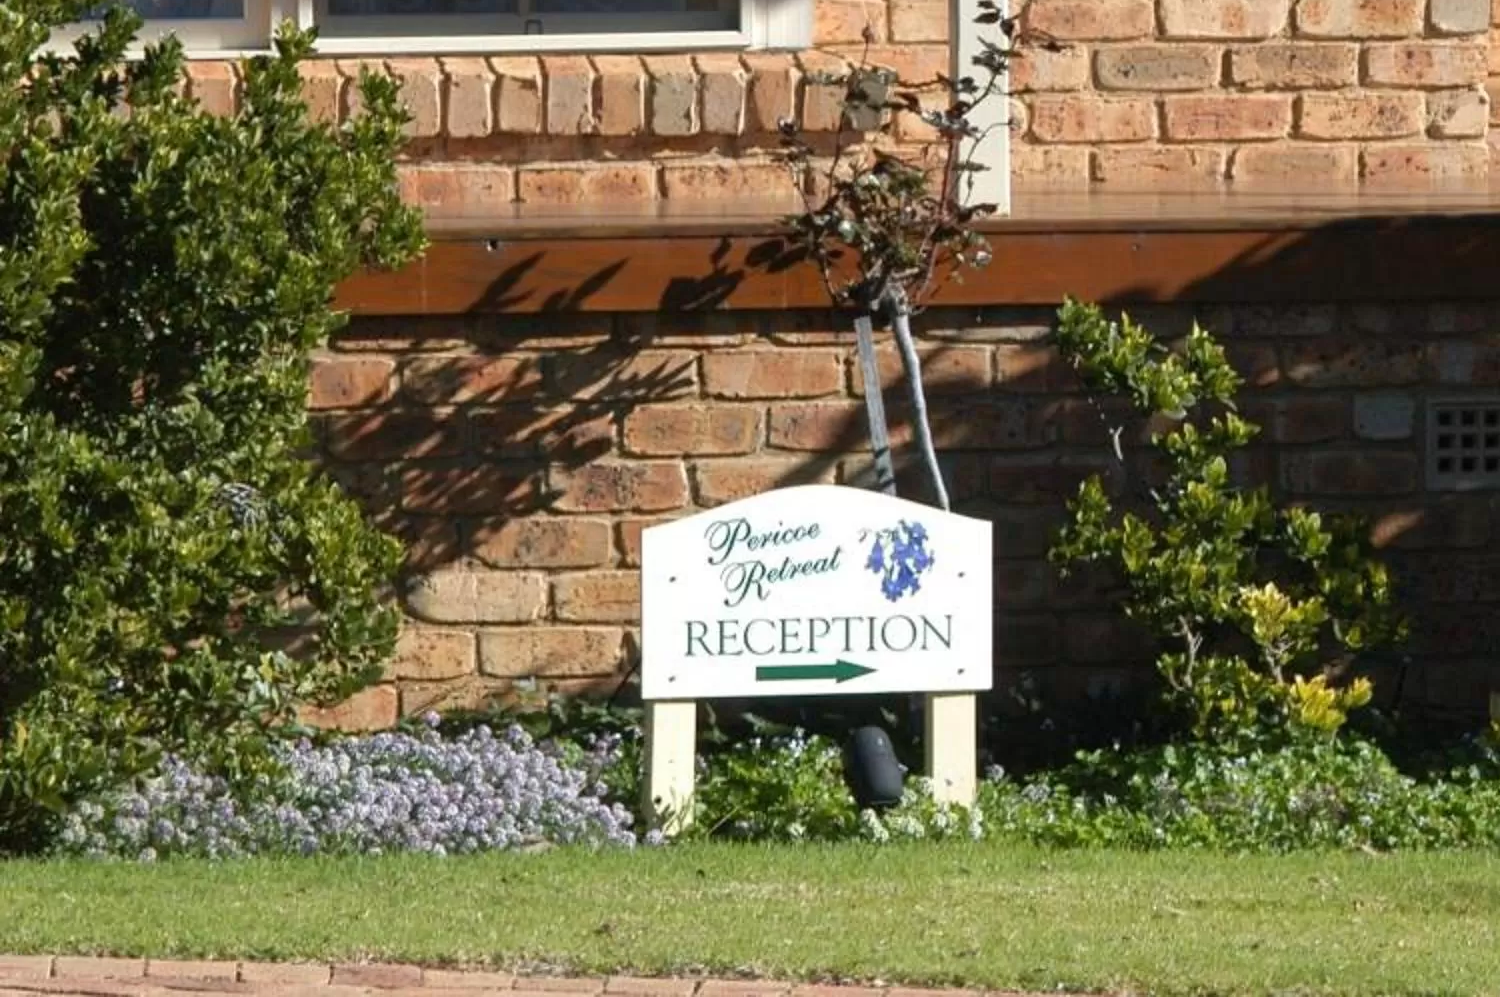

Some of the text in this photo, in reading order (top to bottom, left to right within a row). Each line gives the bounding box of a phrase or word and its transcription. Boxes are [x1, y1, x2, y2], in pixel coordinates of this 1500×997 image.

[704, 517, 821, 566] Pericoe
[720, 545, 843, 608] Retreat
[684, 613, 953, 656] RECEPTION
